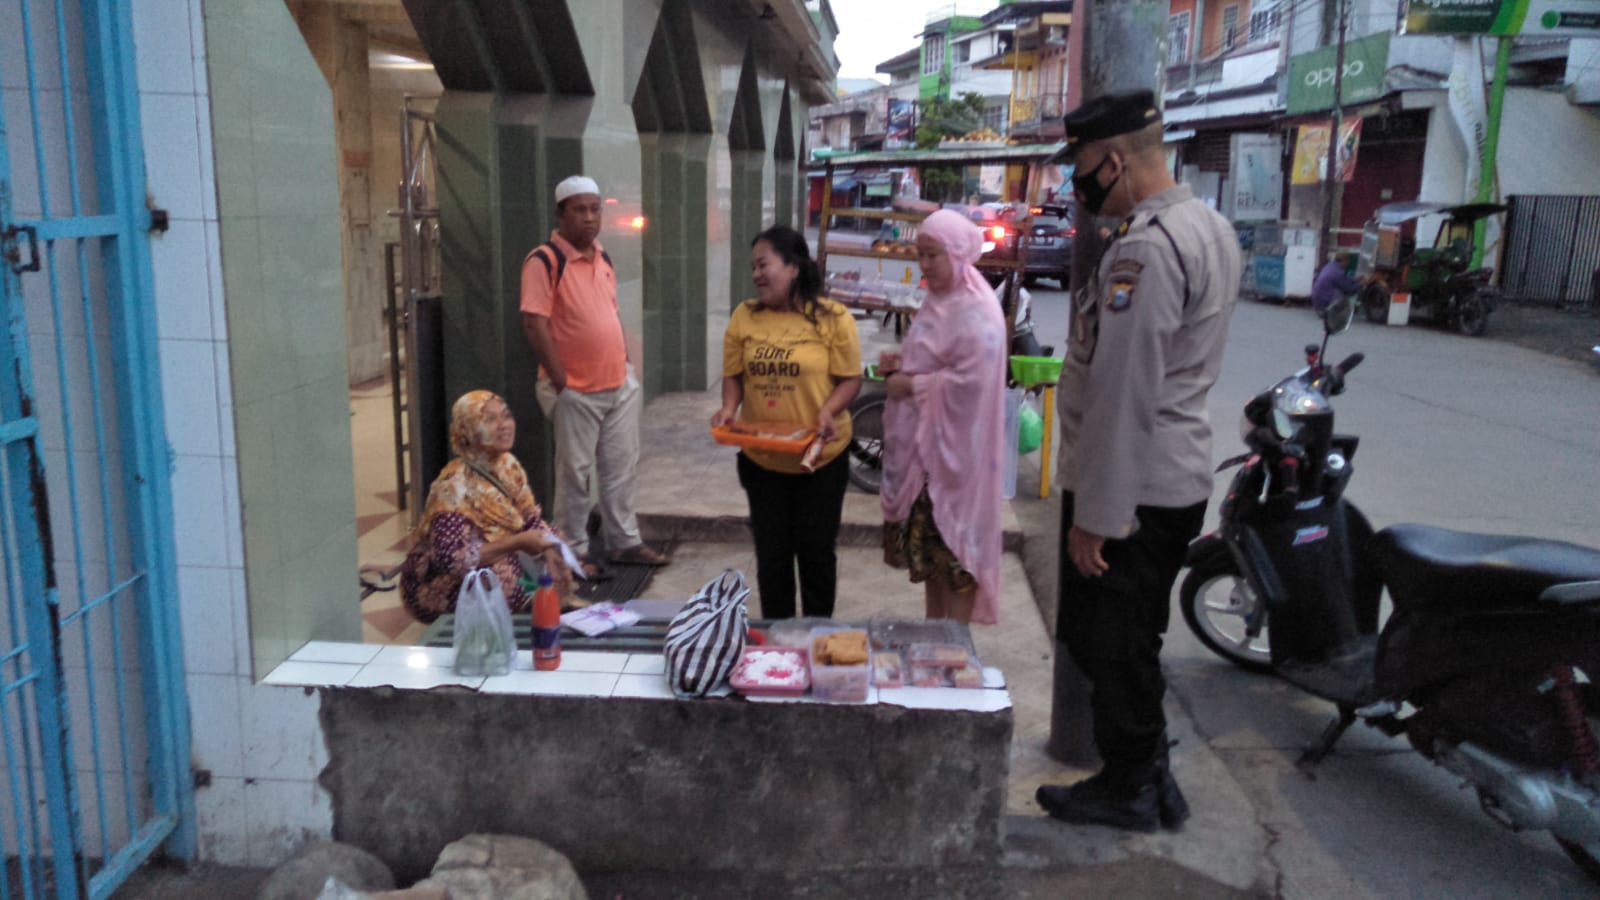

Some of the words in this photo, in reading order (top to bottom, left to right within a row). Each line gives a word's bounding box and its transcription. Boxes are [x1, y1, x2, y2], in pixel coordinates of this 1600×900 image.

[1304, 60, 1364, 89] oppo
[753, 346, 796, 360] SURF
[748, 361, 800, 377] BOARD
